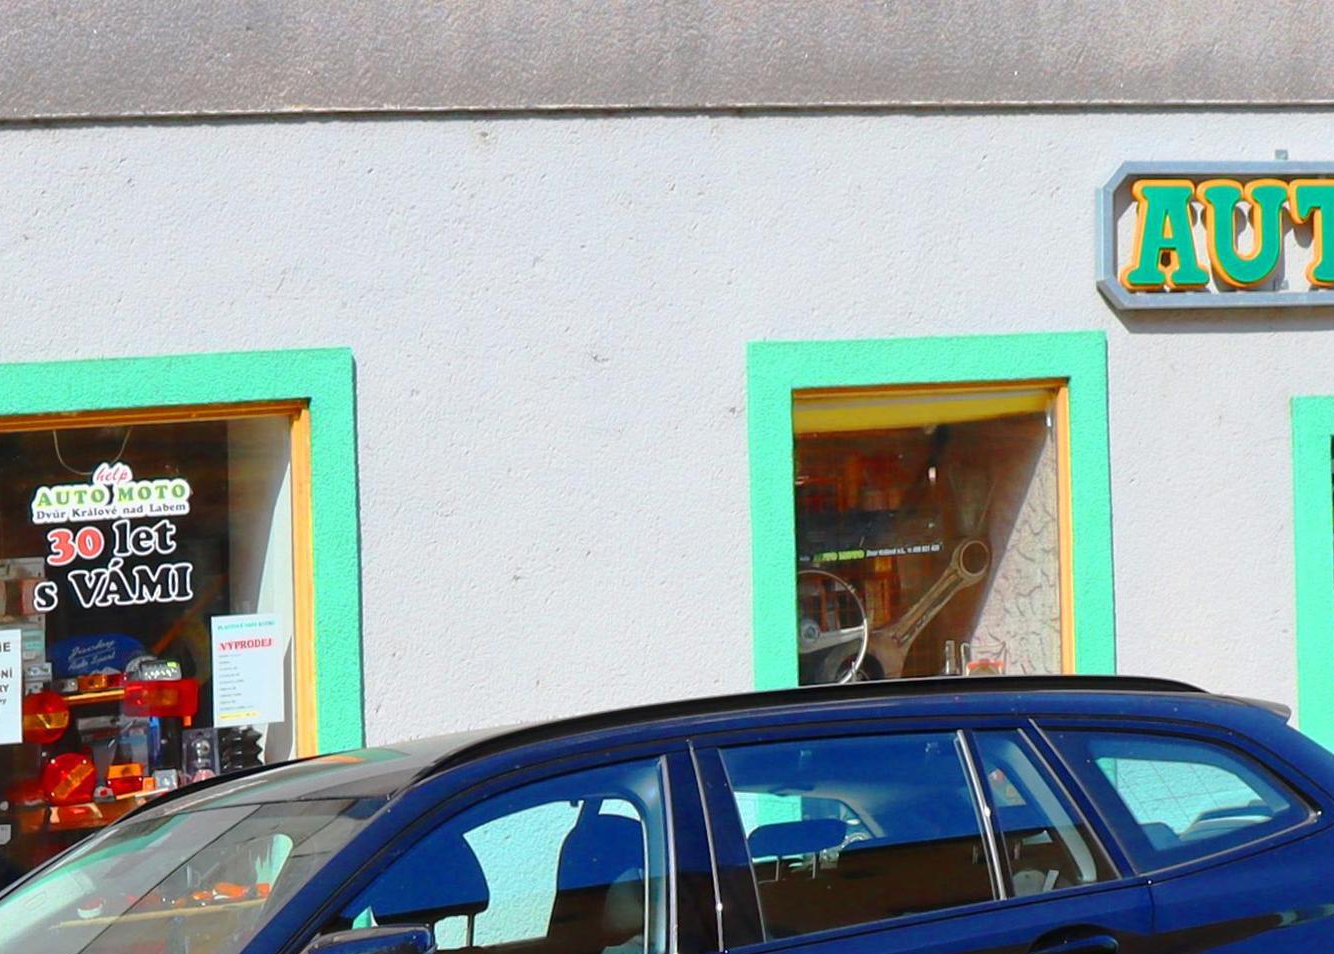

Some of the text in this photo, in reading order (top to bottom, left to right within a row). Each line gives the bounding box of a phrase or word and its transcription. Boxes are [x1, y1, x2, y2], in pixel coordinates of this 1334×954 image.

[96, 465, 128, 484] help
[37, 484, 186, 507] AUTO MOTO
[72, 506, 117, 518] Králové
[123, 505, 144, 514] nad
[150, 503, 186, 512] Labem
[48, 520, 176, 565] 30 let
[34, 558, 193, 611] s VÁMI
